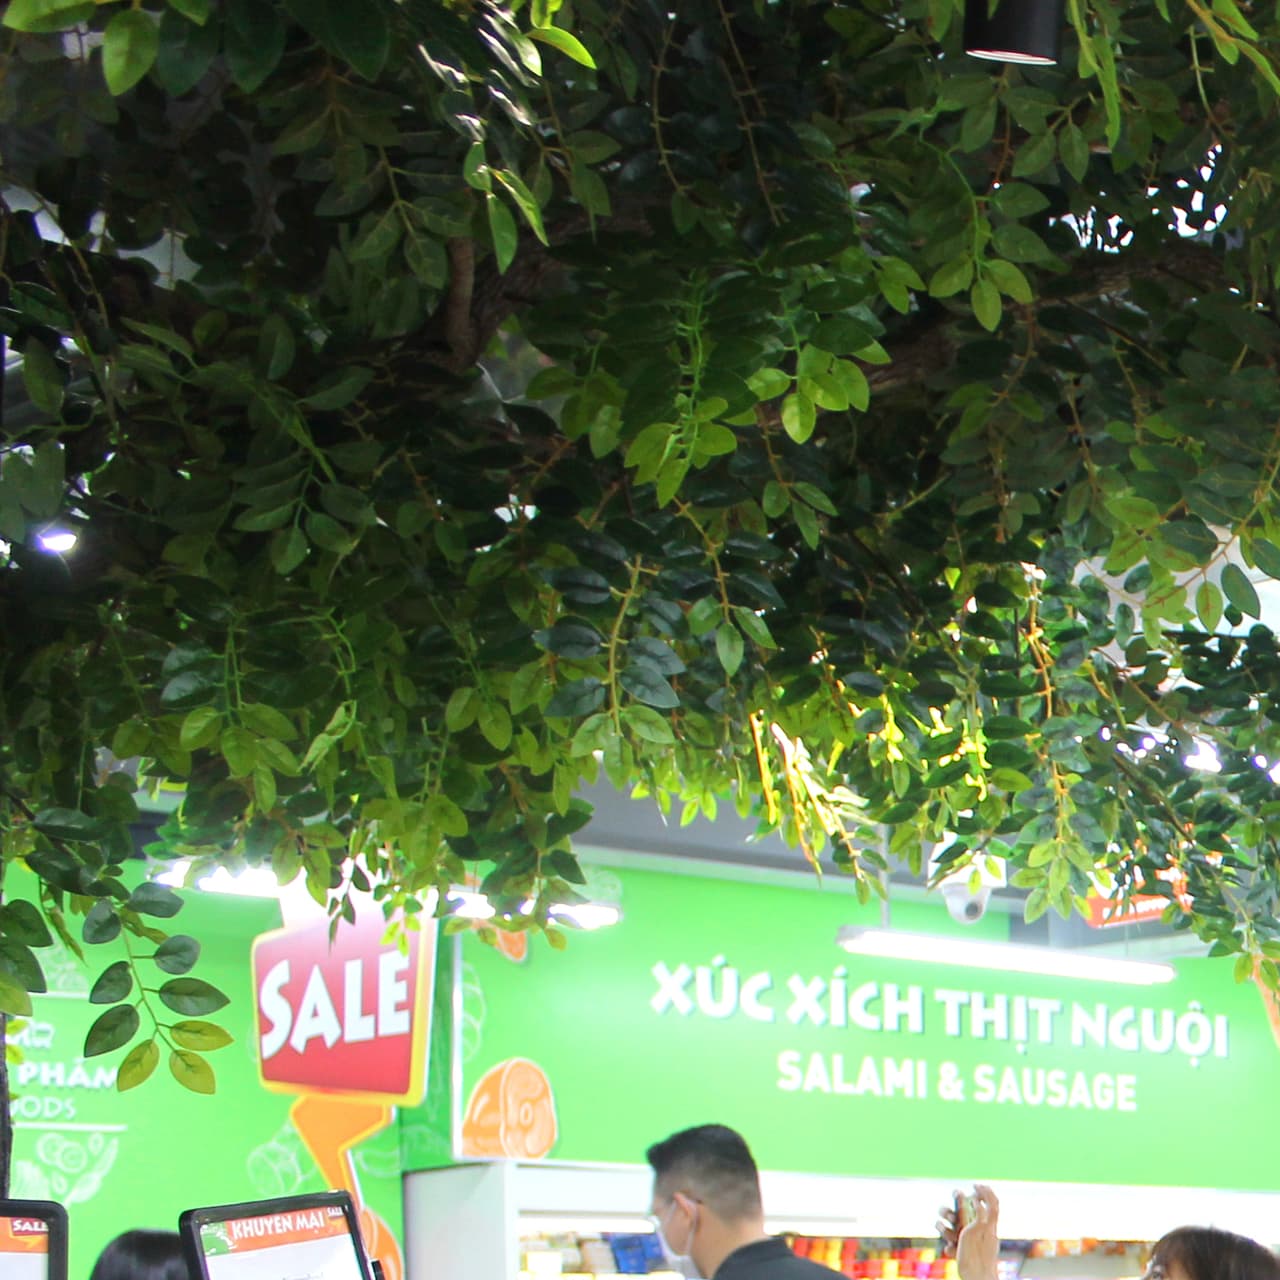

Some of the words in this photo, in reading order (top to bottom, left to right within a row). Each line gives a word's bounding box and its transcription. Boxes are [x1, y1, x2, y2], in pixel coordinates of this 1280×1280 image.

[260, 948, 411, 1060] SALE
[649, 954, 775, 1022] XÚC
[785, 966, 925, 1034] XÍCH
[934, 987, 1064, 1056] THỊT
[1070, 1000, 1230, 1068] NGUỘI
[776, 1049, 928, 1099] SALAMI
[936, 1061, 966, 1102] &
[973, 1062, 1138, 1112] SAUSAGE
